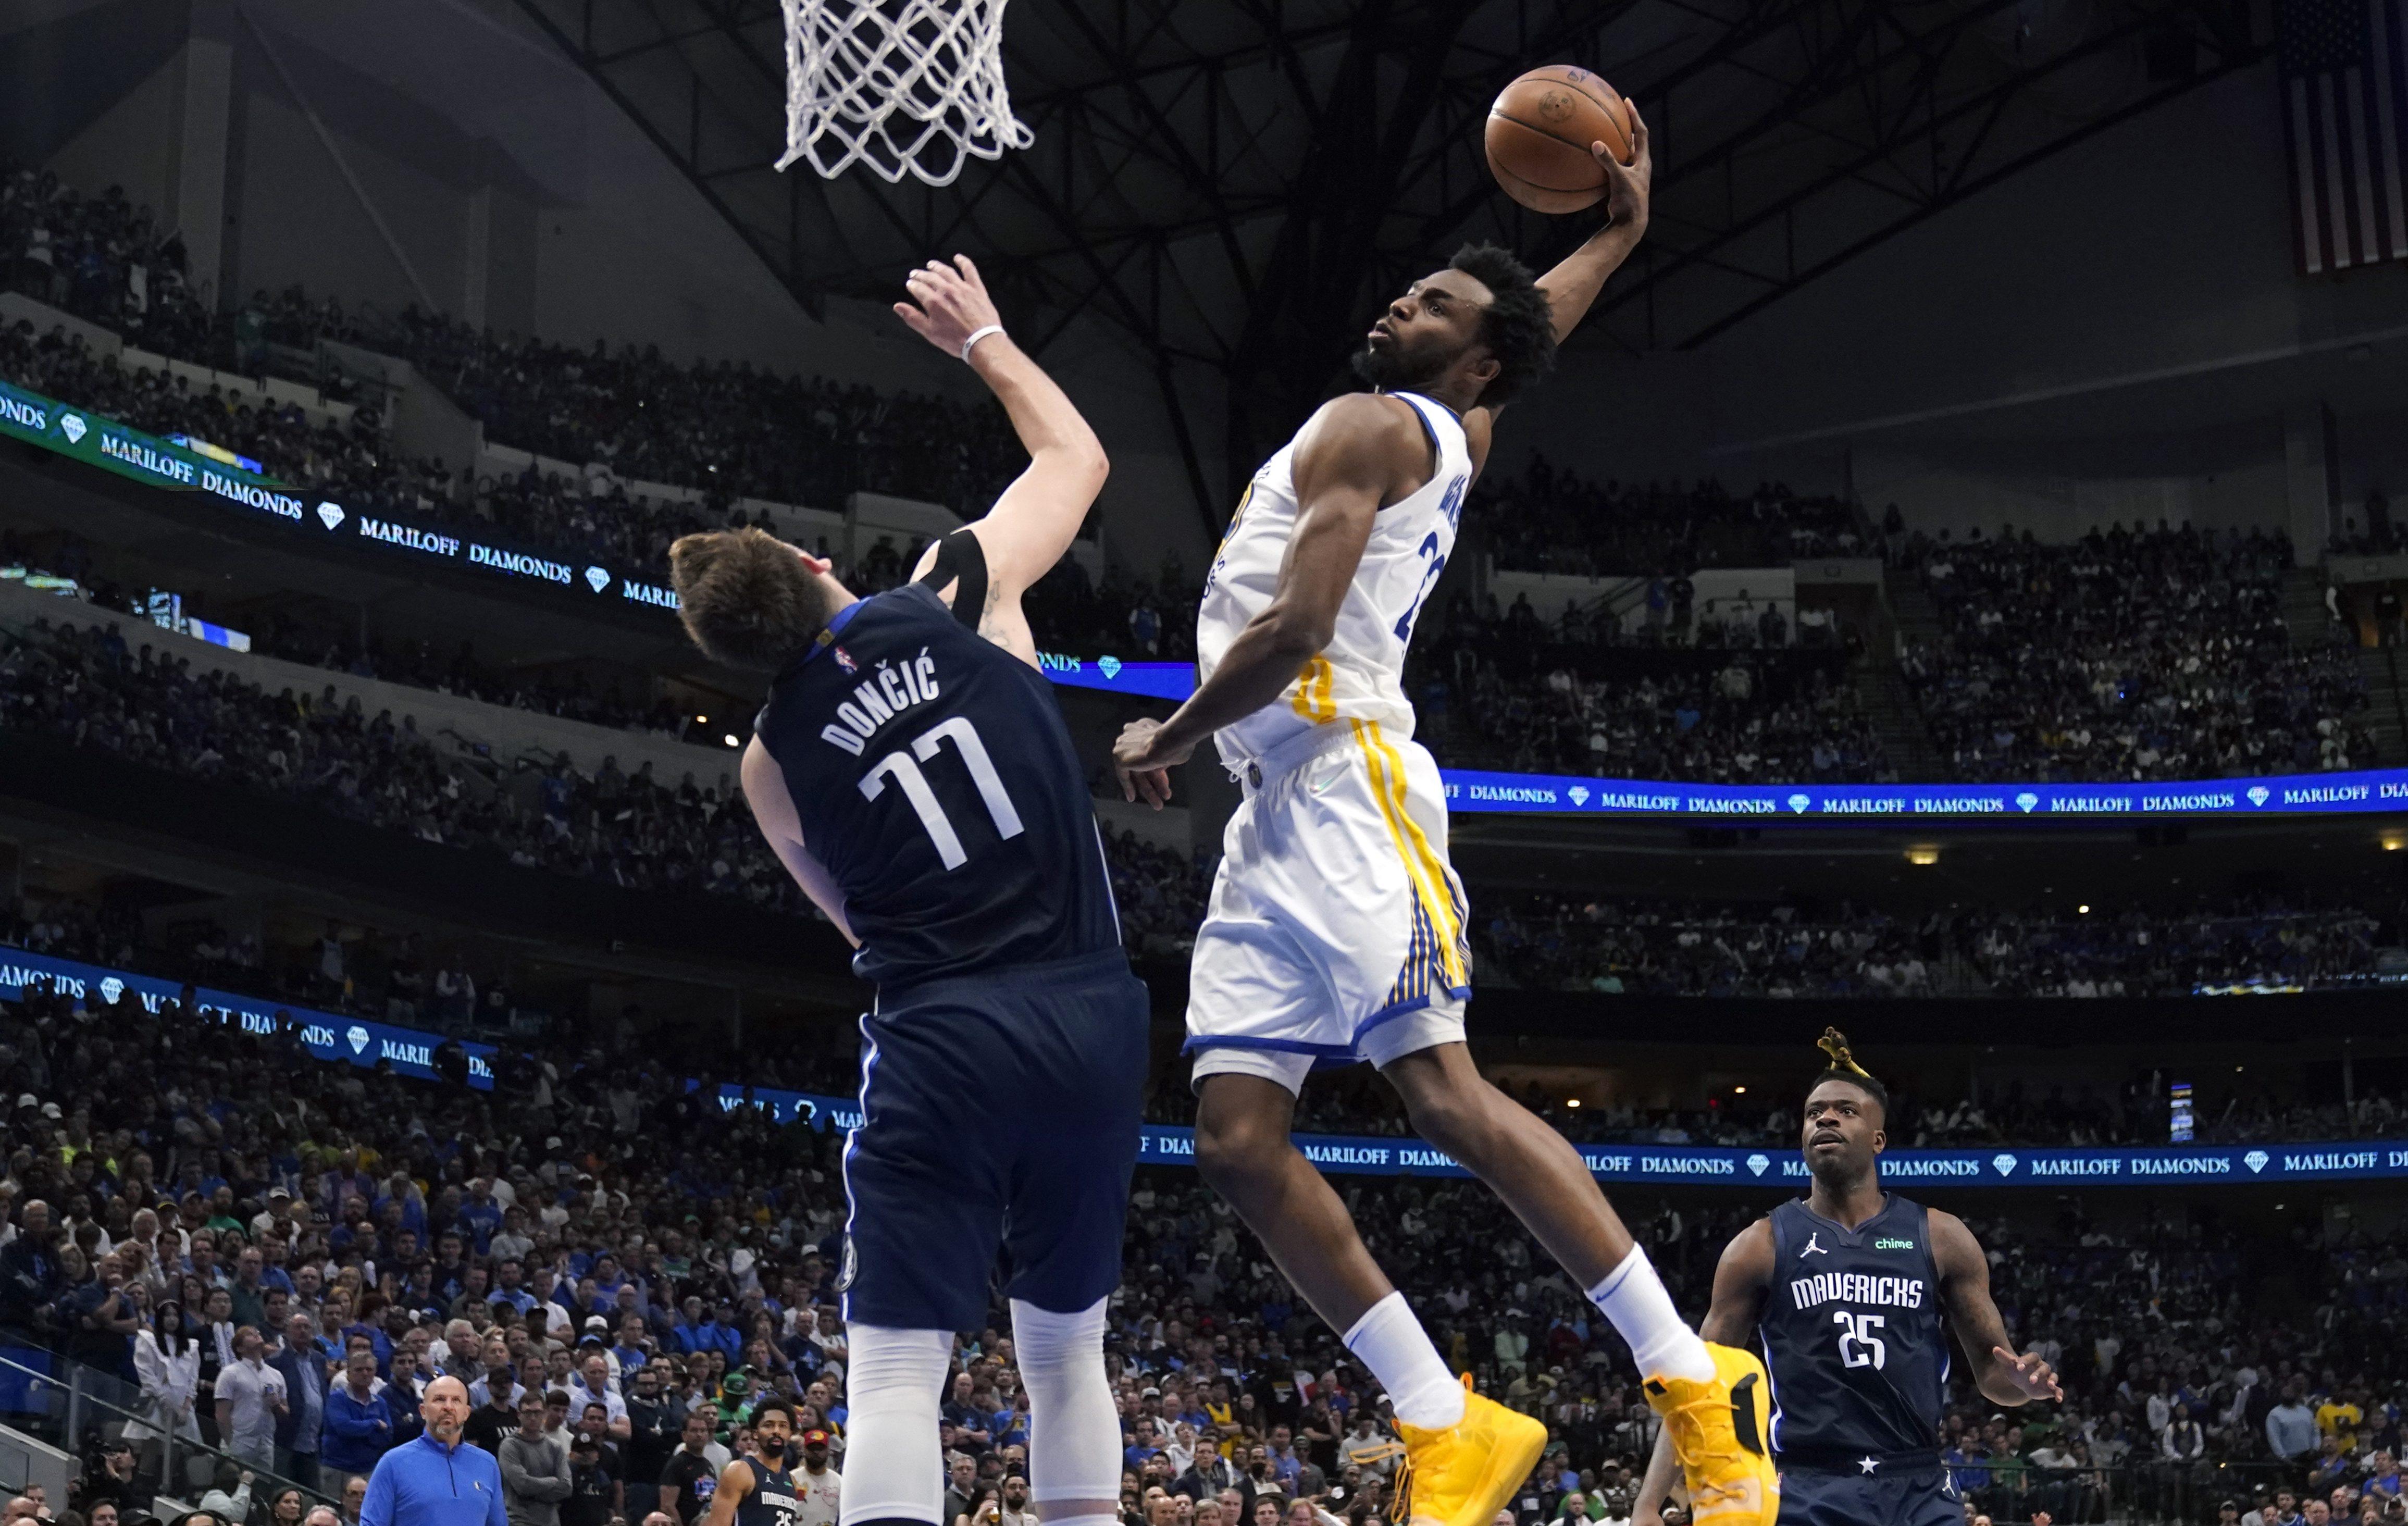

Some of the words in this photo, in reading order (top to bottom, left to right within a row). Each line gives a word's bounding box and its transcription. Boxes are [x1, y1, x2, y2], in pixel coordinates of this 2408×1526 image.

[102, 433, 193, 482] MARILOFF
[203, 470, 302, 519] DIAMONDS
[360, 517, 459, 556] MARILOFF
[470, 544, 571, 584] DIAMONDS
[821, 646, 940, 756] DONČIĆ
[857, 716, 1025, 872] 77
[1470, 785, 1557, 803] DIAMONDS
[1603, 793, 1679, 811] MARILOFF
[1689, 799, 1776, 813] DIAMONDS
[2052, 798, 2130, 811] MARILOFF
[2143, 794, 2235, 811] DIAMONDS
[2285, 786, 2368, 803] MARILOFF
[1823, 799, 1904, 812] MARILOFF
[1915, 799, 2004, 812] DIAMONDS
[242, 1012, 334, 1046] DIANDS
[1160, 1137, 1194, 1155] DIA
[1305, 1146, 1389, 1164] MARILOFF
[1400, 1150, 1463, 1166] DIAMO
[1642, 1157, 1734, 1173] DIAMONDS
[2285, 1152, 2377, 1170] MARILOFF
[1882, 1160, 1979, 1175] DIAMONDS
[2032, 1159, 2121, 1174] MARILOFF
[2132, 1158, 2230, 1174] DIAMONDS
[1875, 1237, 1914, 1250] chime
[1791, 1272, 1923, 1310] MAVERICKS
[1833, 1310, 1886, 1371] 25
